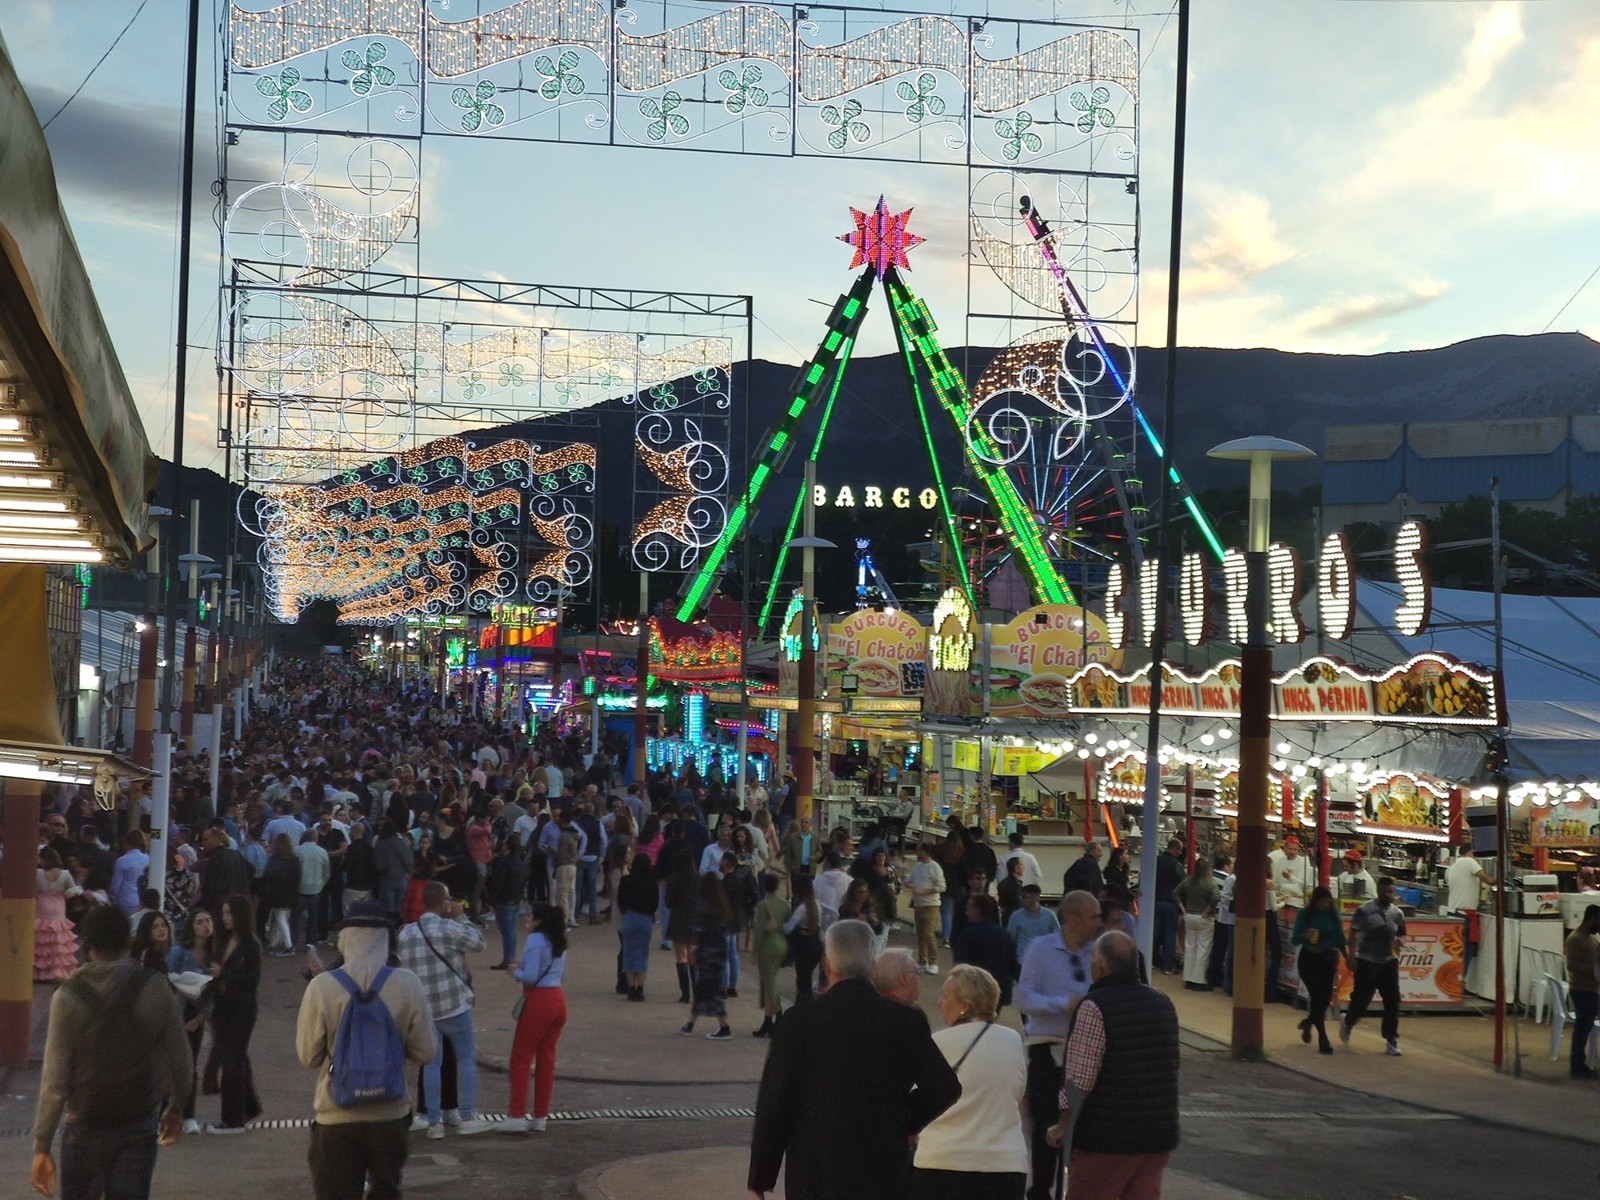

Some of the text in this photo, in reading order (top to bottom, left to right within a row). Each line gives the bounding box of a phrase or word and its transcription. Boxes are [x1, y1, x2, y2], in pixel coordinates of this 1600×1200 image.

[813, 485, 938, 510] BARCO
[1105, 521, 1427, 649] CHURROS
[843, 613, 918, 641] BURGUER
